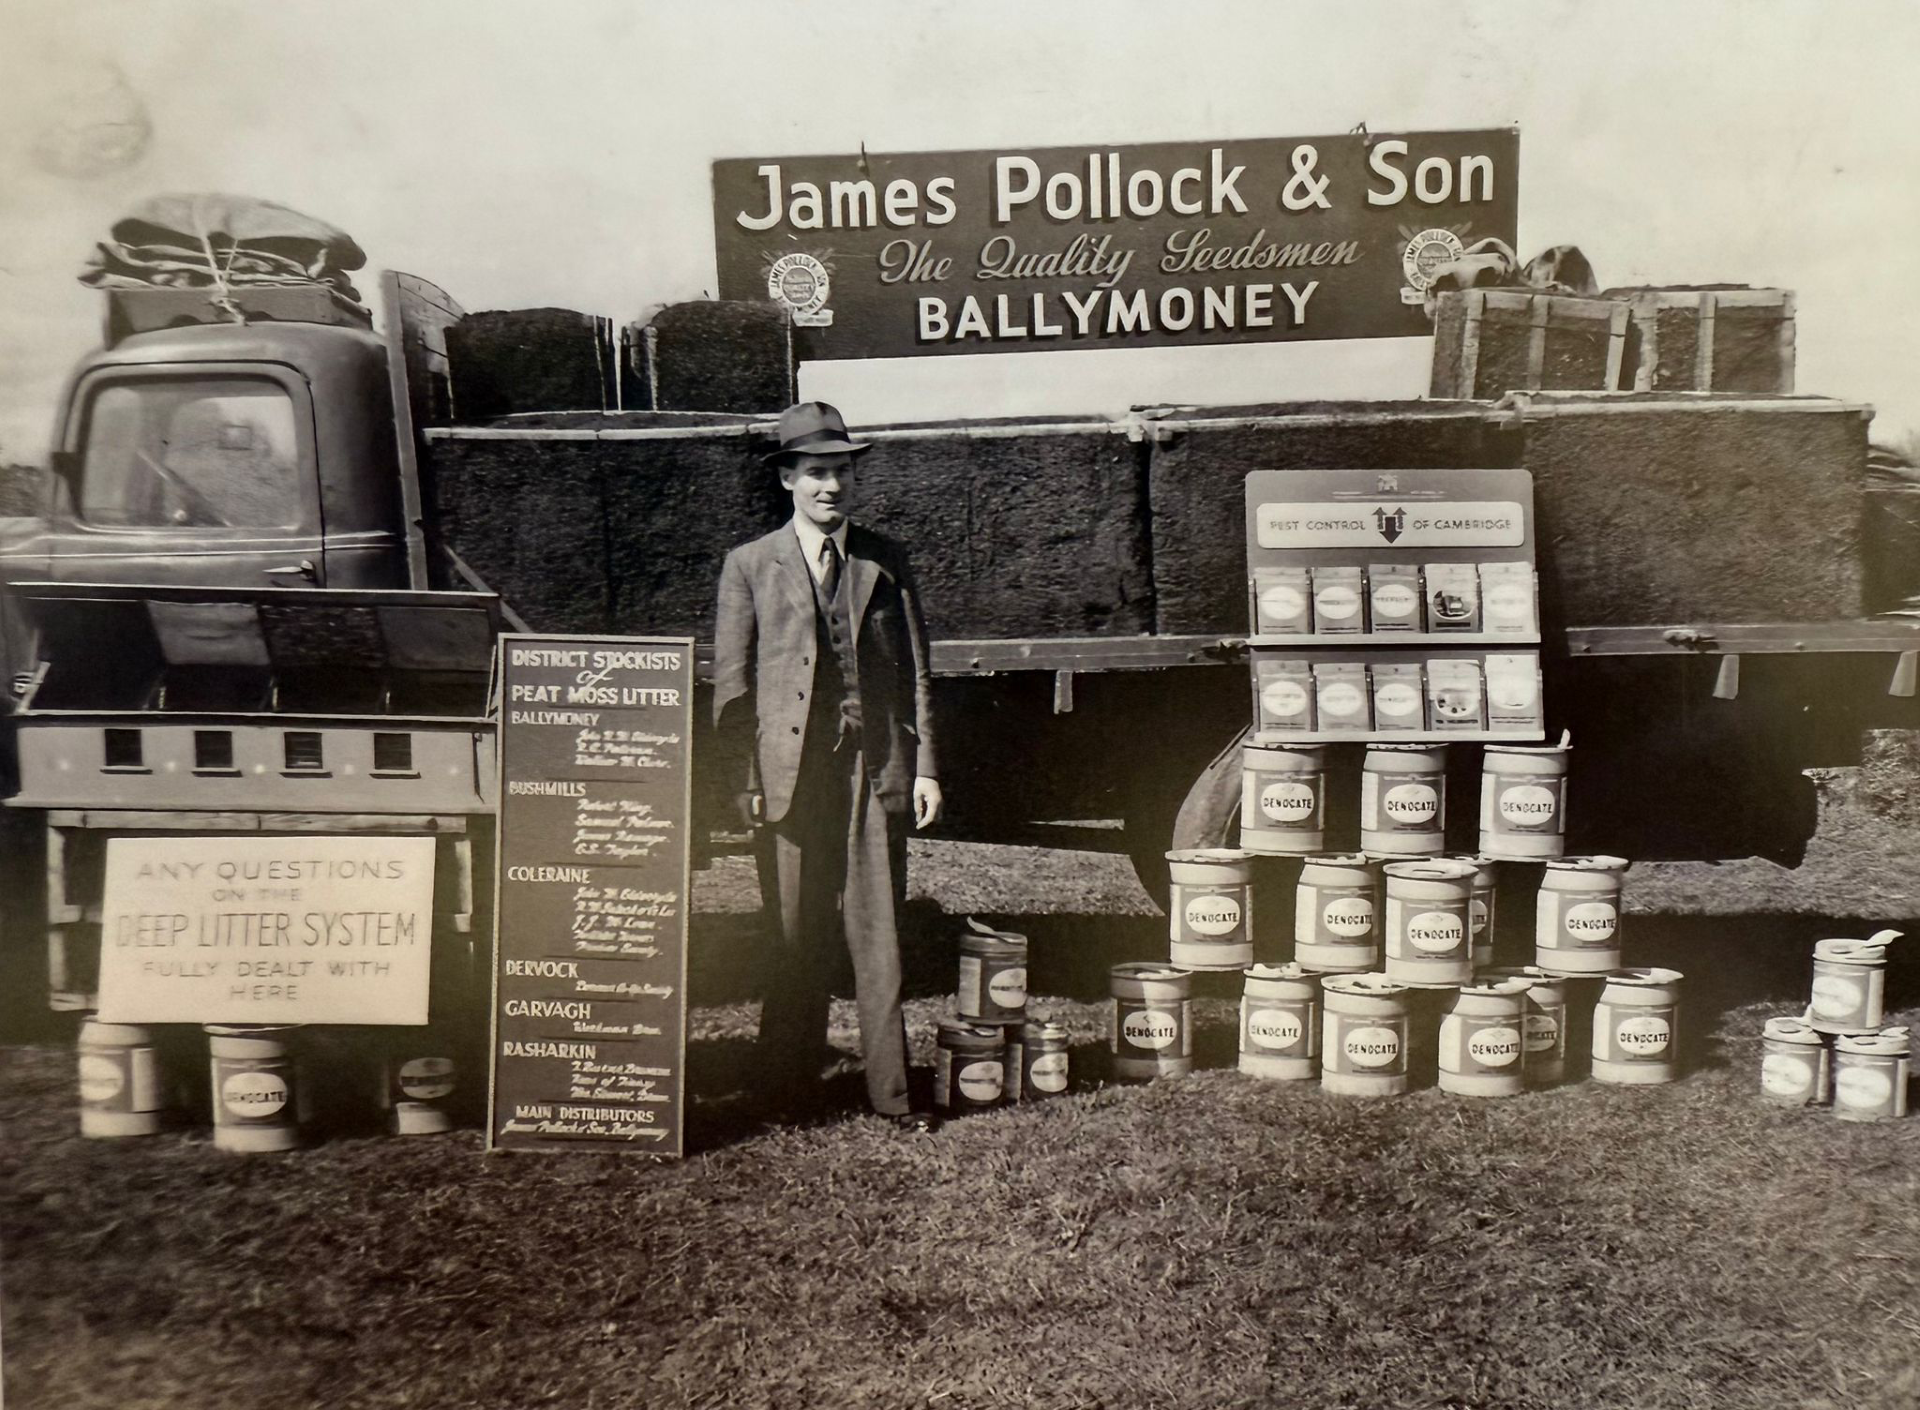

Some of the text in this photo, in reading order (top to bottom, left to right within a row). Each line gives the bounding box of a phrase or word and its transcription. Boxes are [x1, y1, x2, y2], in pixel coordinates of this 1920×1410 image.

[737, 140, 1494, 231] James Pollock & Son
[878, 228, 1365, 288] The Quality Seedsmen
[918, 281, 1319, 340] BALLYMONEY
[1270, 519, 1513, 532] PEST CONTROL OF CAMBRIDGE
[511, 649, 681, 671] DISTRICT STOCKISTS
[511, 685, 681, 706] PEAT MOSS LITTER
[511, 711, 600, 726] BALLYMONEY
[509, 781, 586, 797] BUSHMILLS
[1263, 797, 1313, 809] DENOCATE
[1387, 800, 1436, 811] DENOCATE
[1503, 802, 1553, 813] DENOCATE
[138, 860, 404, 882] ANY QUESTIONS
[507, 866, 591, 884] COLERAINE
[212, 888, 301, 902] ON THE
[1189, 912, 1238, 923] DENOCATE
[1567, 918, 1616, 929] DENOCATE
[115, 912, 416, 947] DEEP LITTER SYSTEM
[1411, 928, 1461, 939] DENOCATE
[143, 961, 391, 978] FULLY DEALT WITH
[505, 959, 579, 978] DERVOCK
[231, 985, 299, 1001] HERE
[504, 999, 592, 1019] GARVAGH
[1125, 1026, 1174, 1038] DENOCATE
[1250, 1025, 1299, 1038] DENOCATE
[1620, 1032, 1669, 1043] DENOCATE
[502, 1041, 596, 1059] RASHARKIN
[1347, 1043, 1397, 1055] DENOCATE
[515, 1105, 655, 1122] MAIN DISTRIBUTORS
